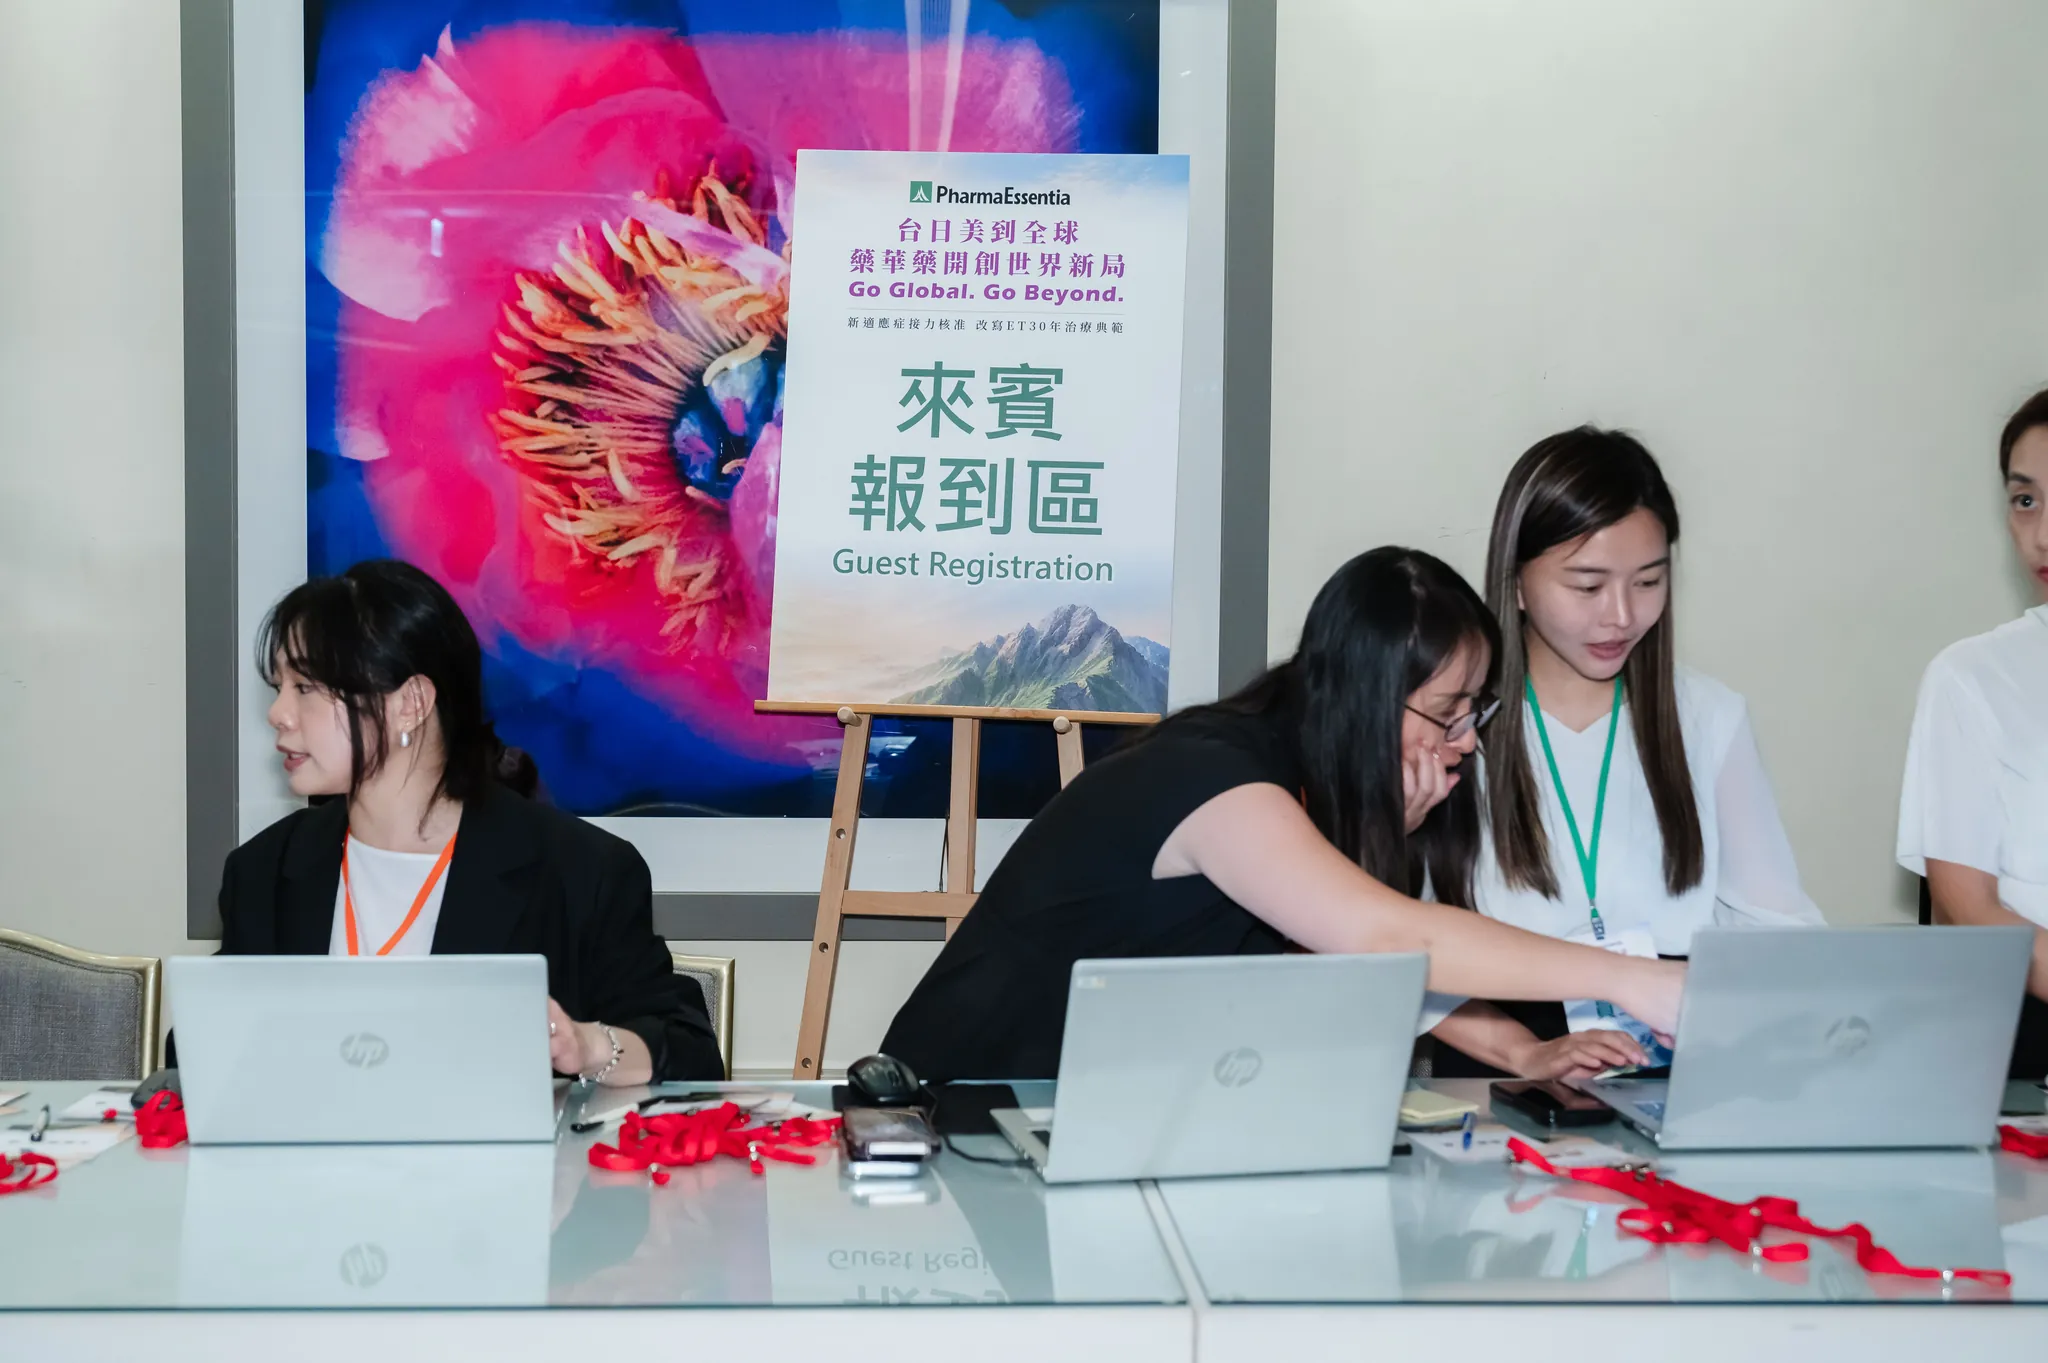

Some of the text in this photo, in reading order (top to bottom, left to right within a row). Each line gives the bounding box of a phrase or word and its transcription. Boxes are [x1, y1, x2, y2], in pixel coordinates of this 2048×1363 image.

[937, 185, 1071, 206] PharmaEssentia
[898, 217, 1079, 245] 台日美到全球
[849, 248, 1126, 279] 藥華藥開創世界新局
[848, 280, 1124, 306] Go Global. Go Beyond.
[847, 316, 1124, 334] 新適應症接力核准 改寫ET30年治療典範
[896, 360, 1064, 442] 來賓
[848, 454, 1105, 536] 報到區
[832, 548, 1114, 586] Guest Registration
[339, 1031, 390, 1070] hp
[1213, 1046, 1264, 1088] hp
